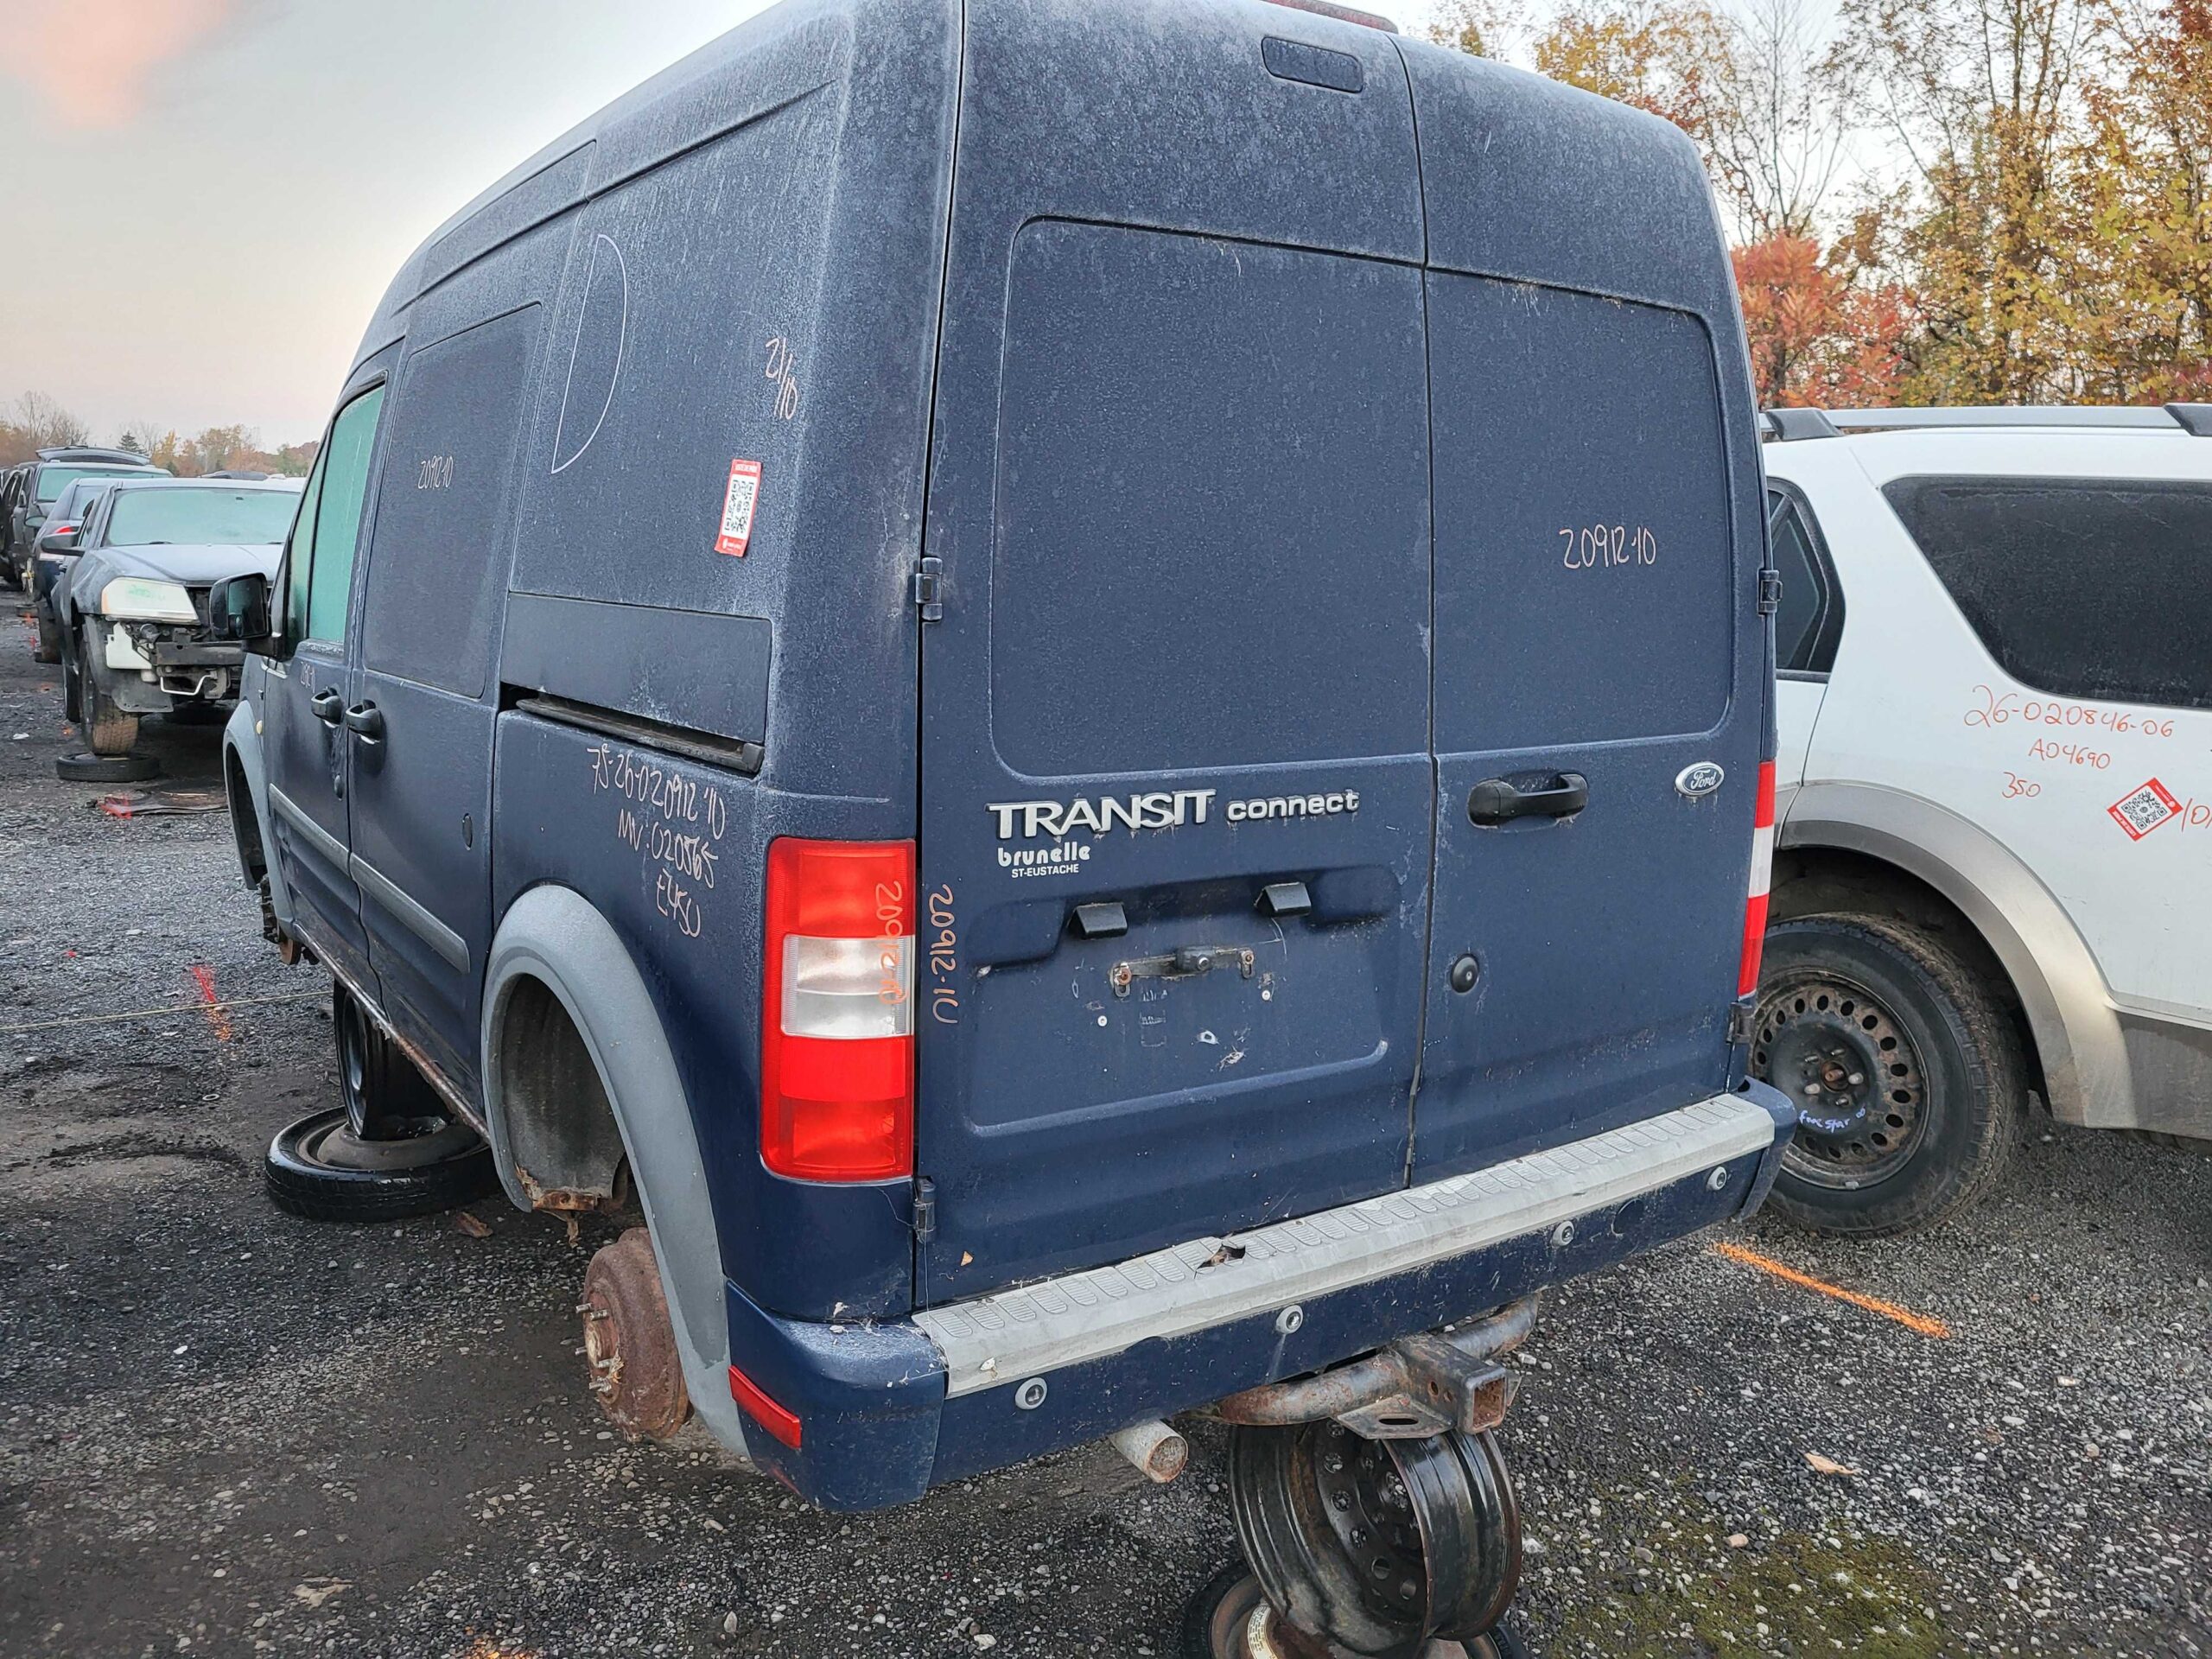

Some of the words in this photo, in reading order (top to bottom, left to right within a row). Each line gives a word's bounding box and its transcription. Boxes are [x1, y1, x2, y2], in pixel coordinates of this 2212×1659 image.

[1963, 684, 2175, 737] 26-020846-06
[2028, 738, 2111, 769] A04690
[1690, 766, 1718, 787] Ford
[2001, 772, 2042, 798] 350
[987, 788, 1217, 839] TRANSIT
[1226, 790, 1361, 823] connect
[997, 841, 1091, 868] brunelle
[1011, 864, 1080, 879] ST-EUSTACHE
